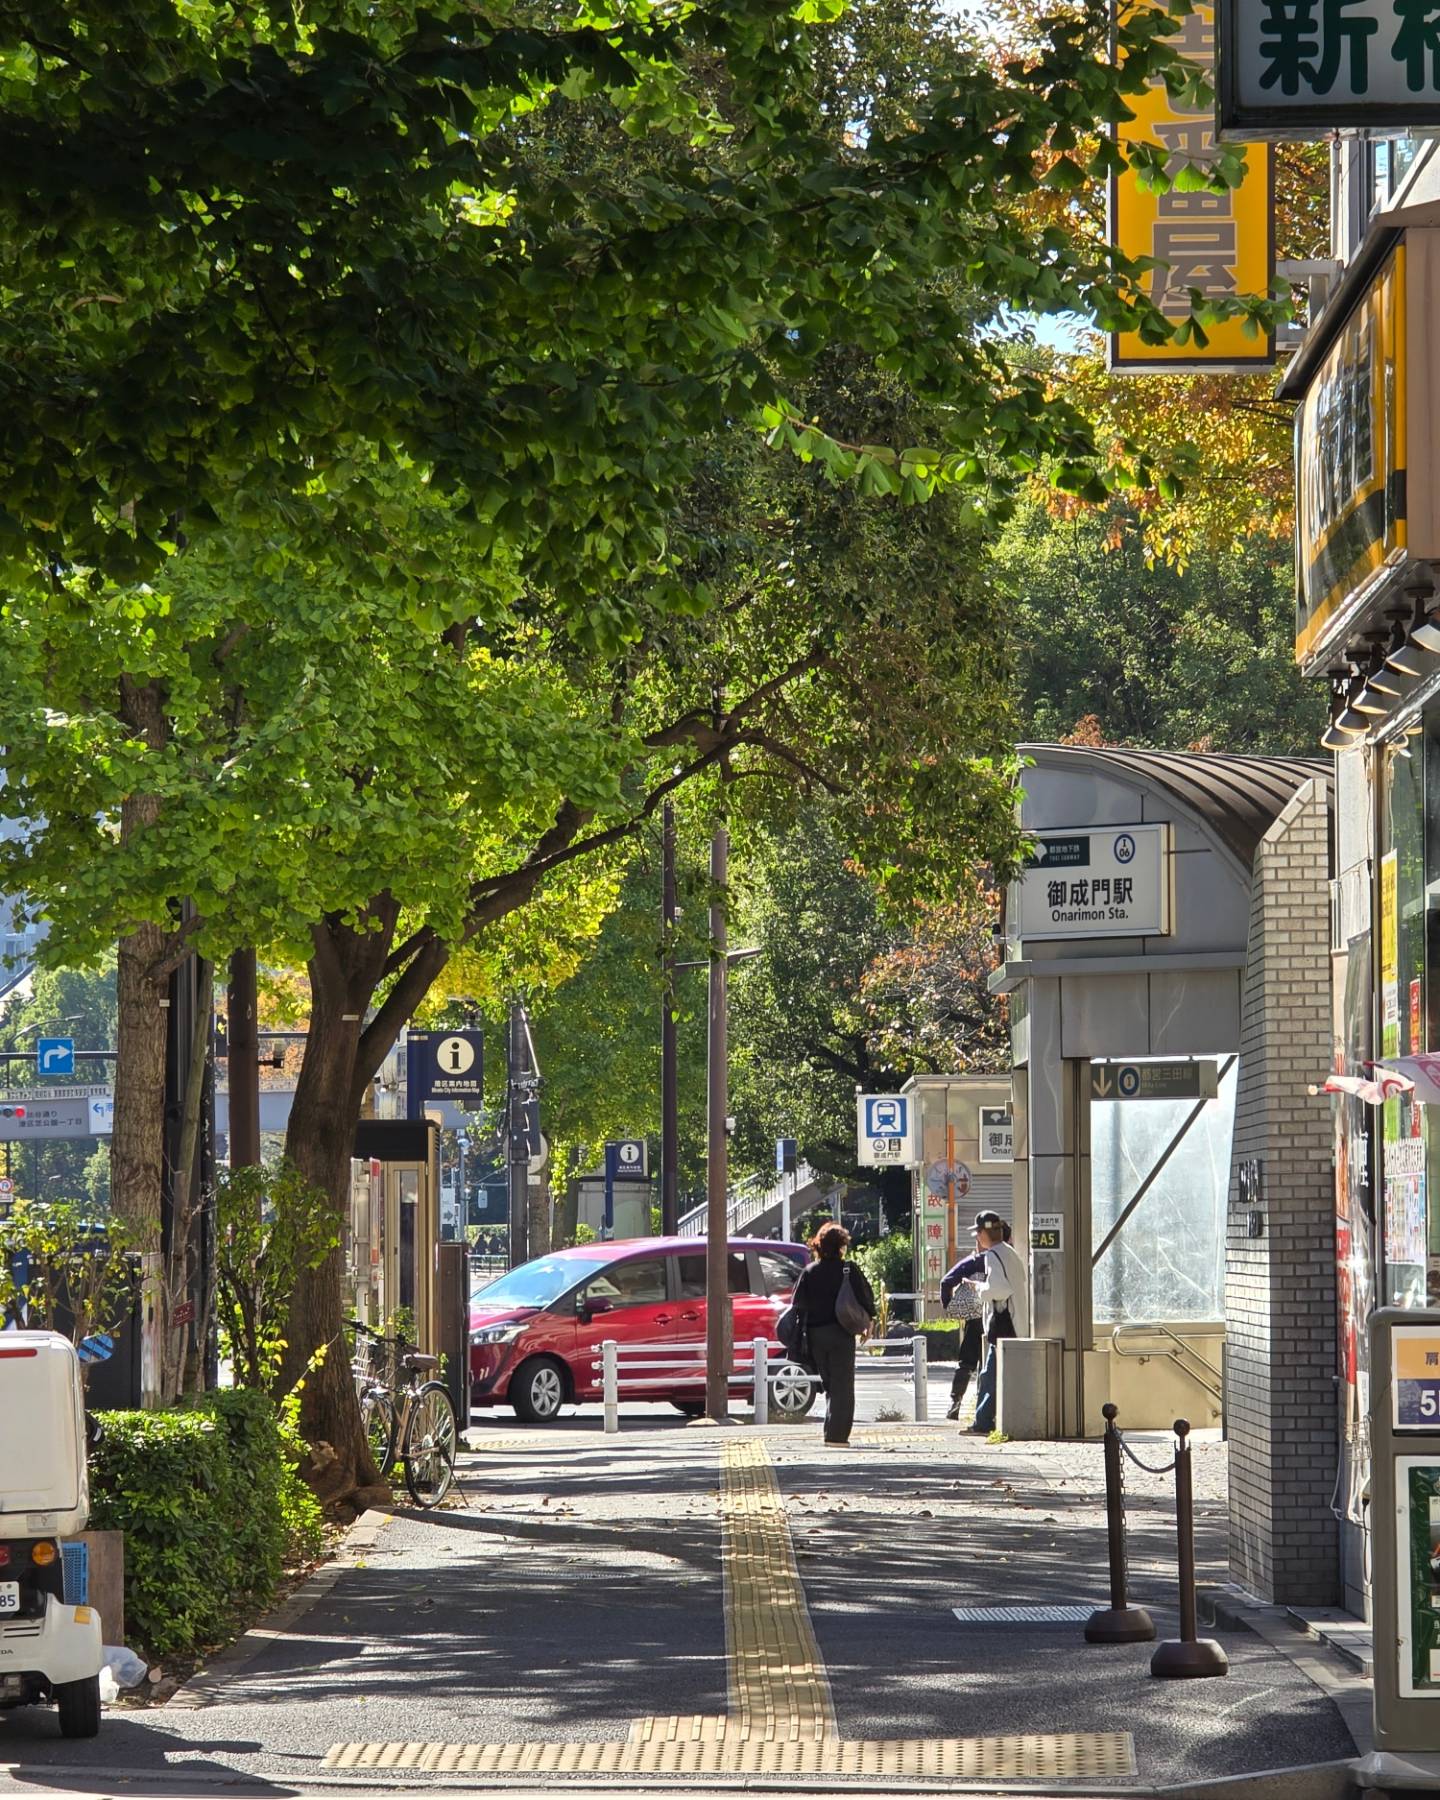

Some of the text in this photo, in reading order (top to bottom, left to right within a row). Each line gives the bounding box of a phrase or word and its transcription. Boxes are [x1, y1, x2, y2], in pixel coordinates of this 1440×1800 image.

[1119, 848, 1130, 858] 06
[1047, 877, 1133, 908] 御成門駅
[1052, 907, 1129, 922] Onarimon Sta.
[1039, 1232, 1055, 1246] A5
